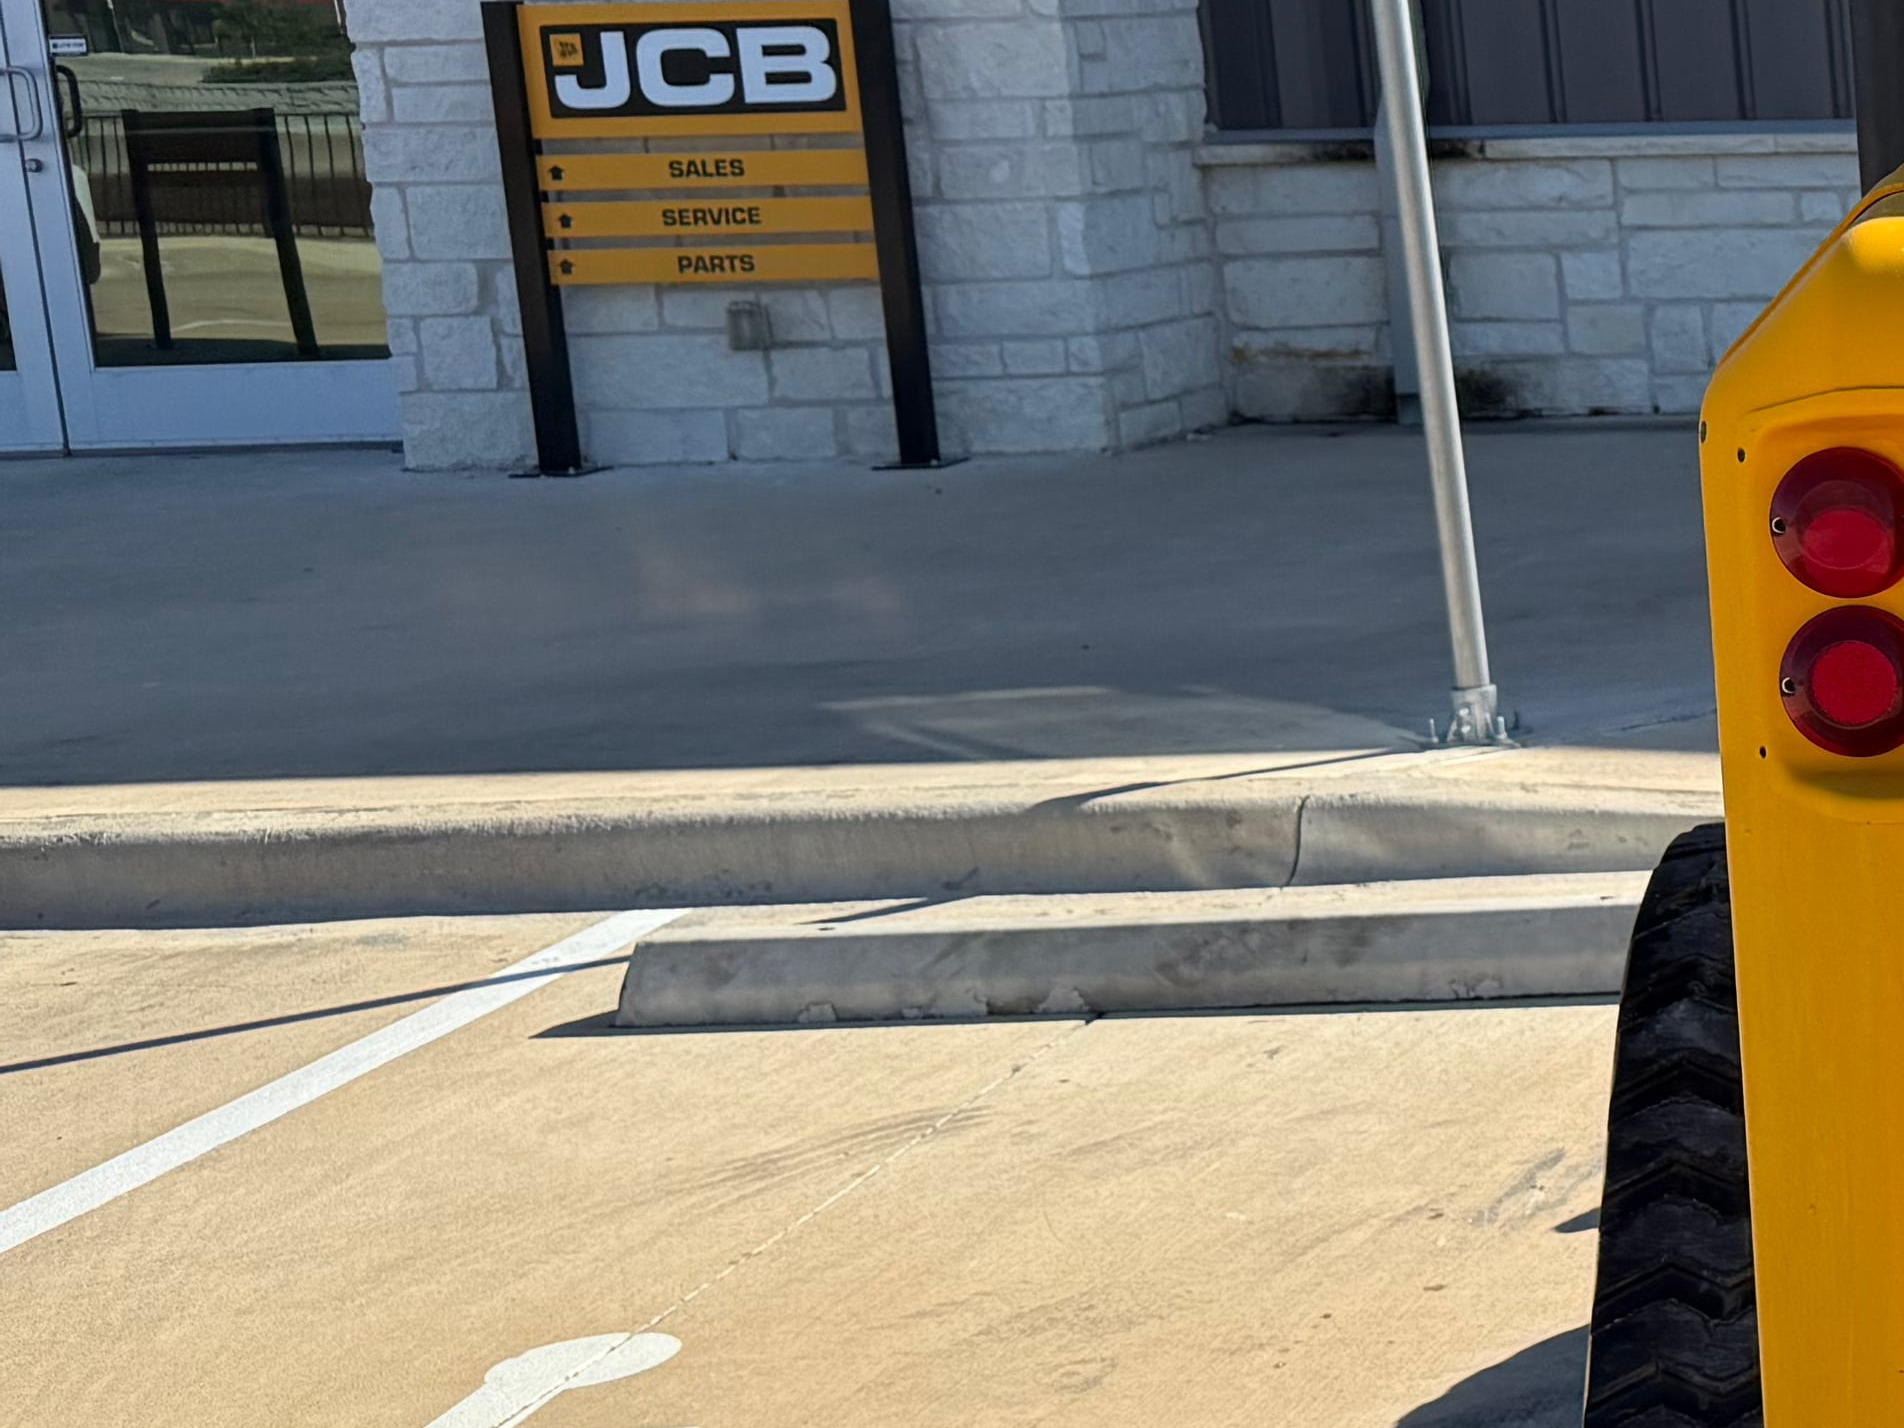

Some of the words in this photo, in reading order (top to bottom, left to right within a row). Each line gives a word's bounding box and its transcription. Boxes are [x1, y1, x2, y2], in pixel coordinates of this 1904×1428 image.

[554, 26, 837, 109] JCB
[668, 158, 747, 179] SALES
[661, 206, 762, 228] SERVICE
[677, 254, 755, 274] PARTS
